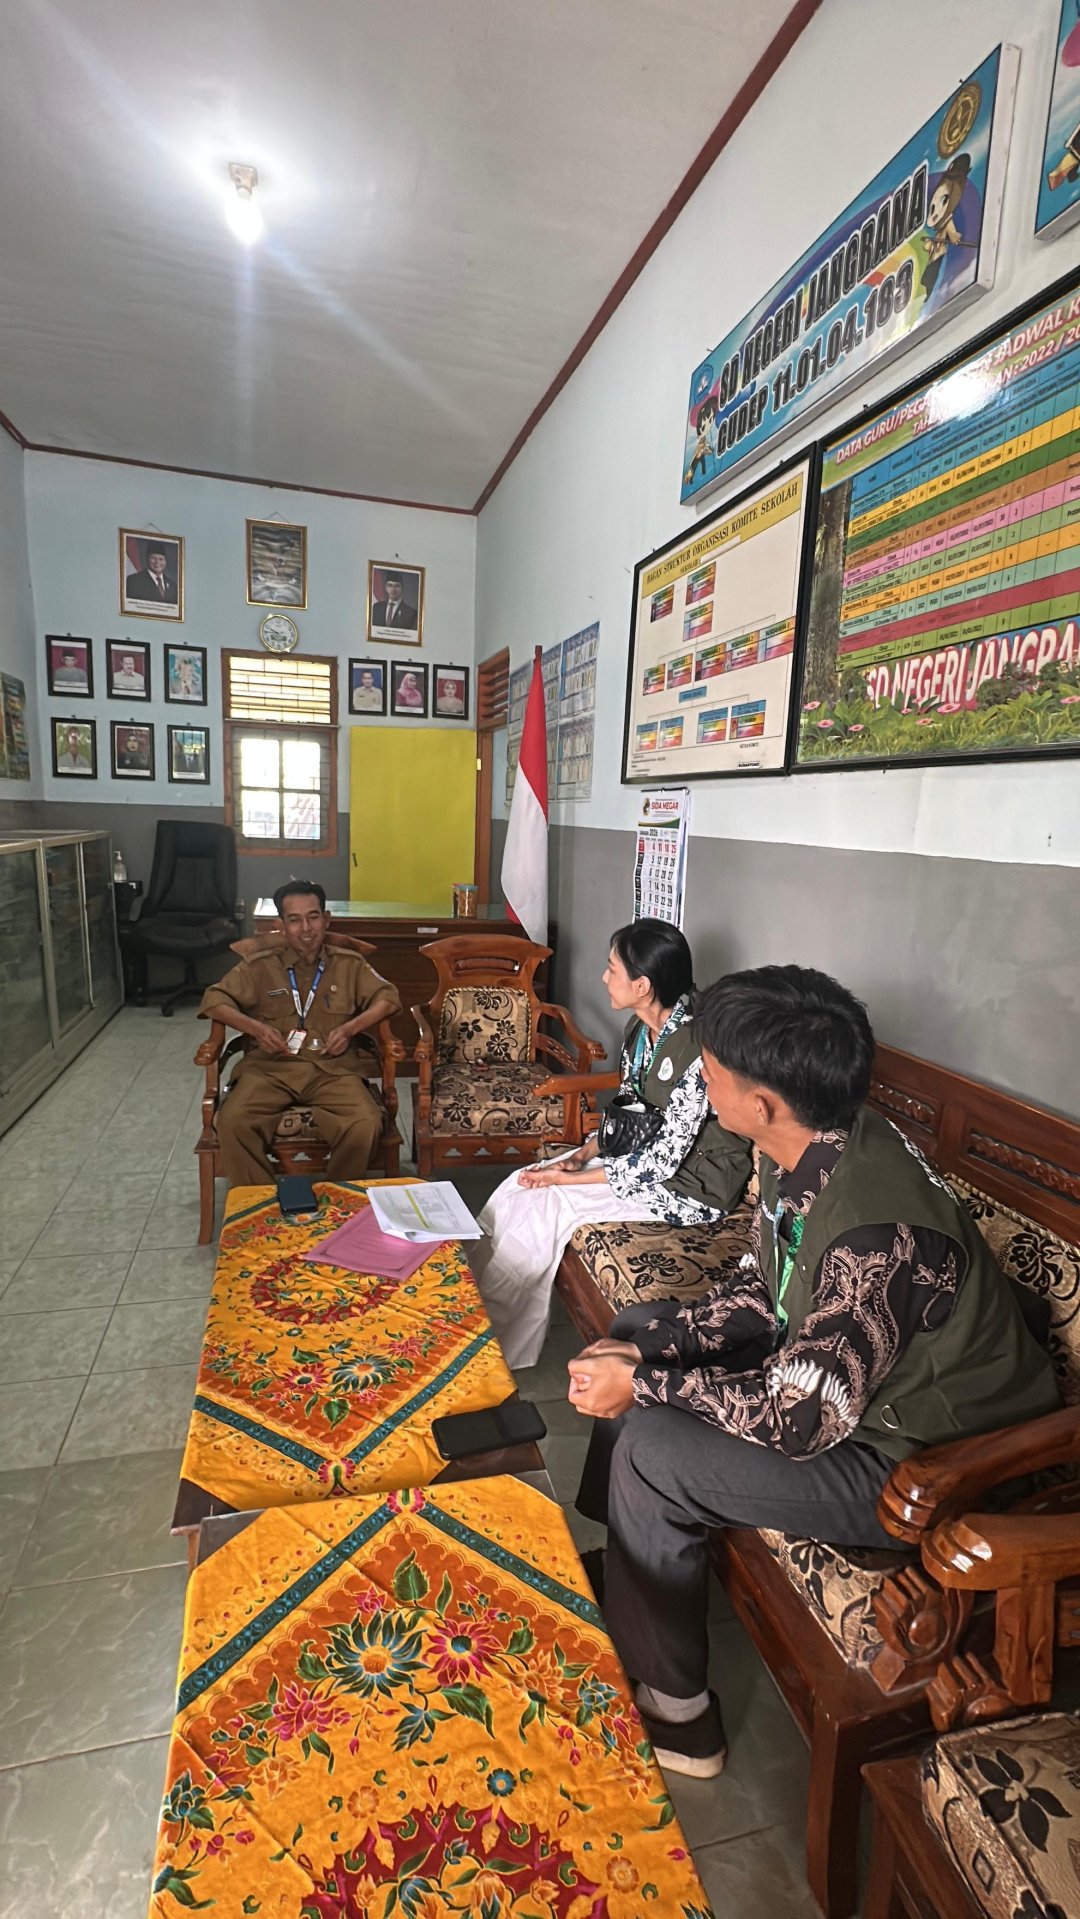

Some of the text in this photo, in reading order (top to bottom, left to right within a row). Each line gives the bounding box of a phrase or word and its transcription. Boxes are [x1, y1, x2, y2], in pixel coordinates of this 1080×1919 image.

[719, 163, 927, 410] SD NEGERI JANGRANA
[717, 384, 769, 457] GUDEP
[772, 258, 914, 413] 11.01.04.183
[836, 437, 863, 465] DATA
[663, 549, 691, 575] STRUKTUR
[692, 527, 729, 557] ORGANISASI
[731, 507, 758, 534] KOMITE
[760, 481, 799, 515] SEKOLAH
[671, 844, 677, 854] 25
